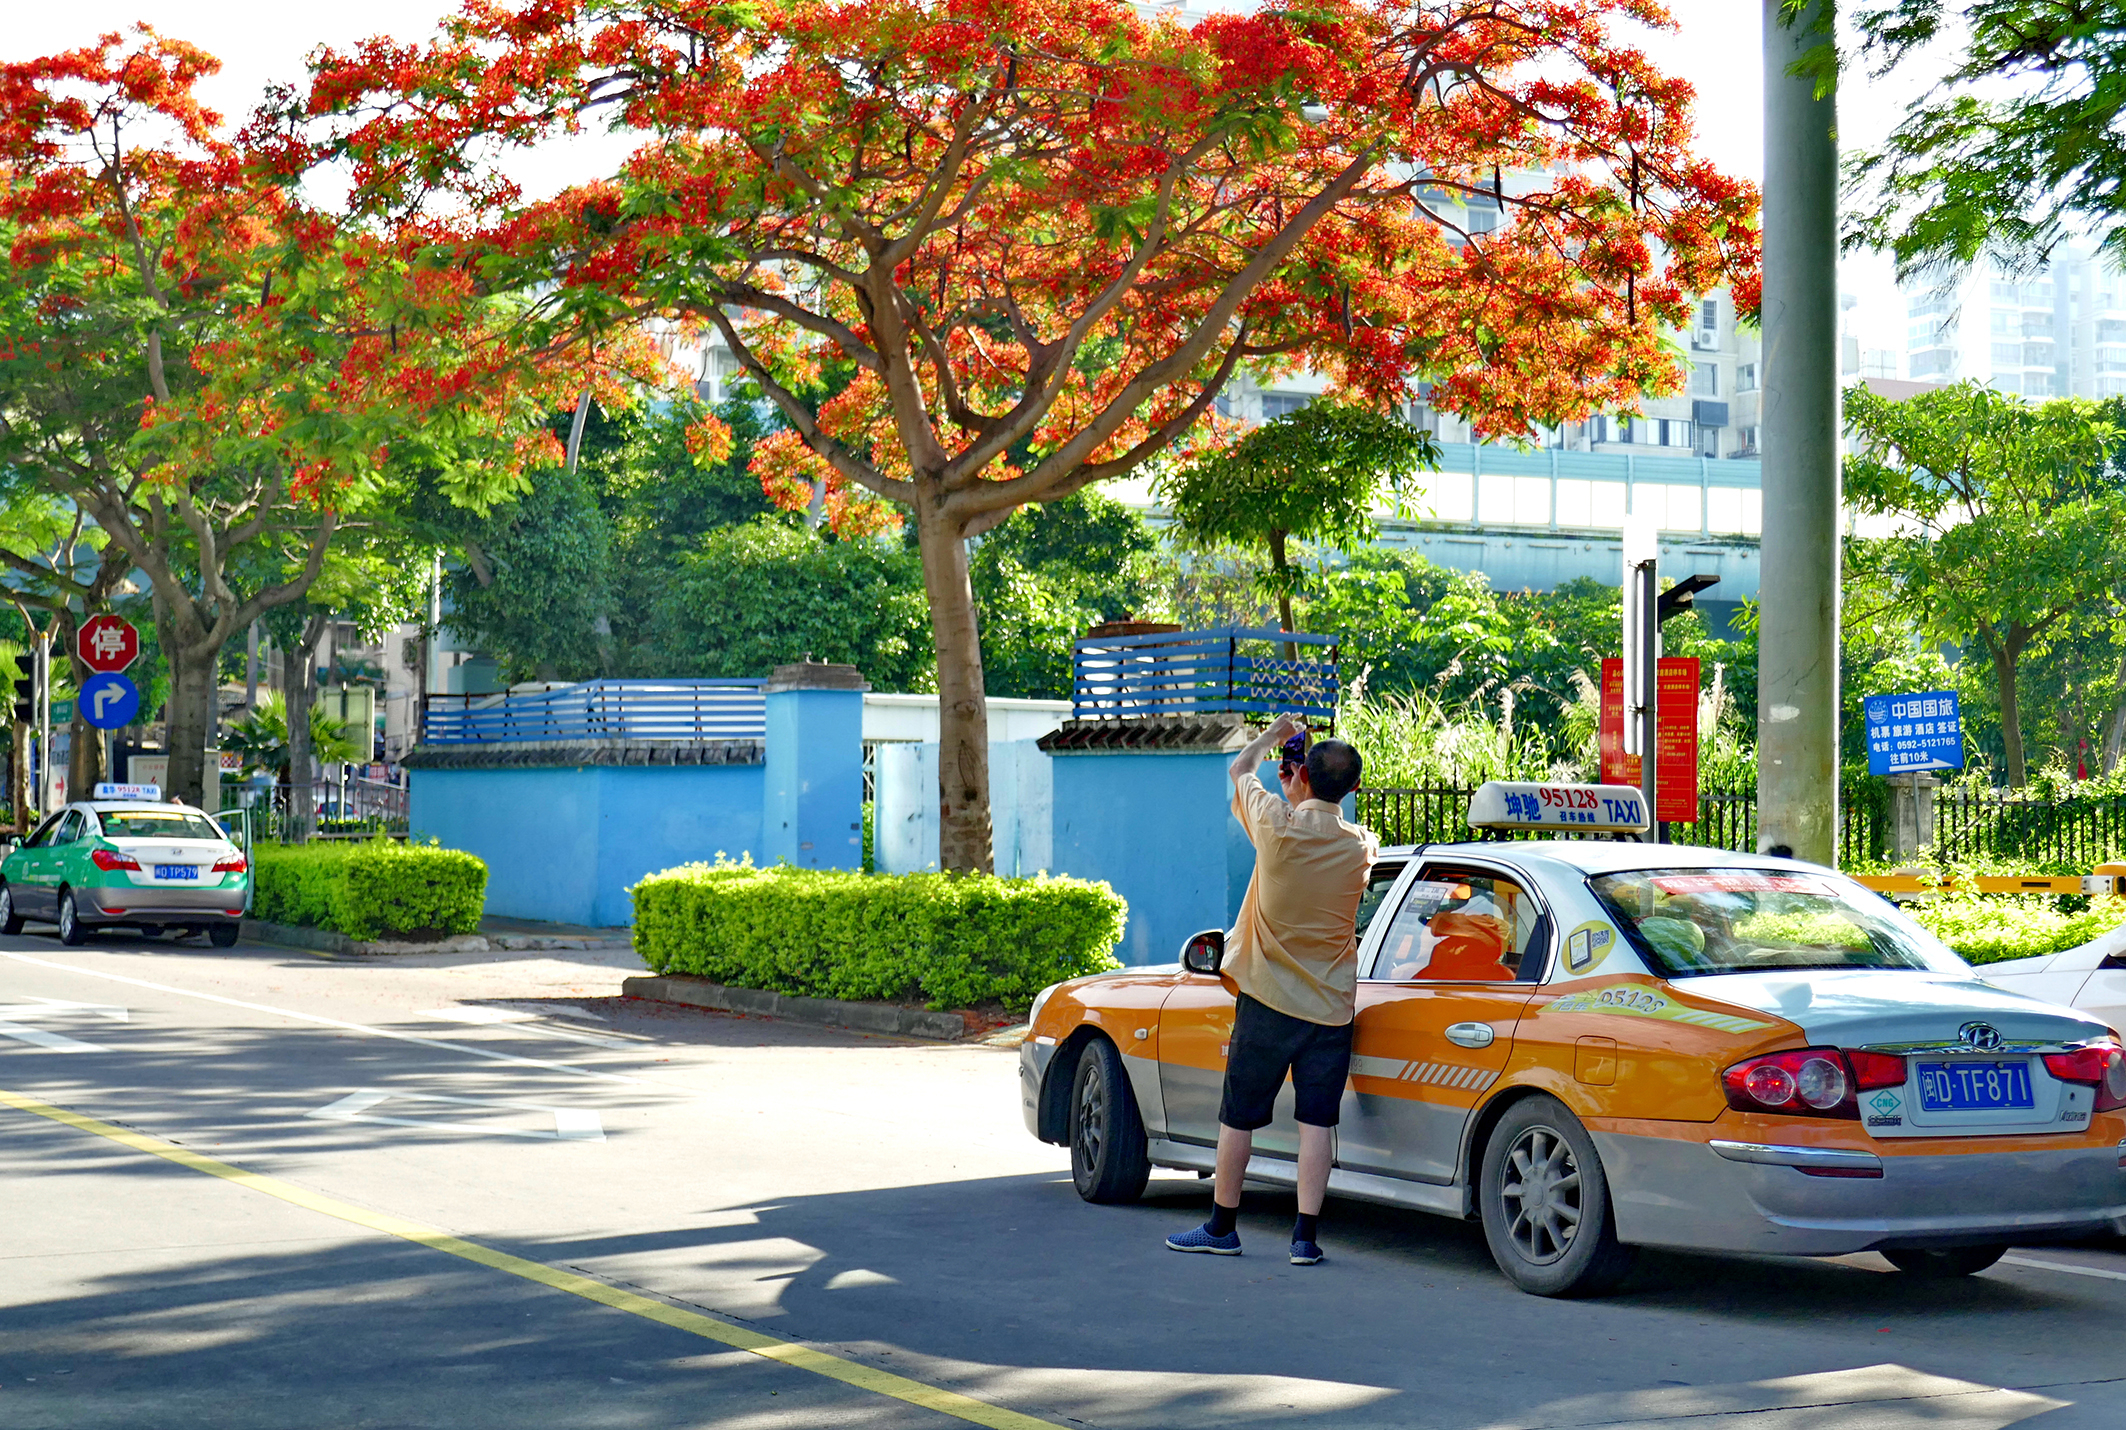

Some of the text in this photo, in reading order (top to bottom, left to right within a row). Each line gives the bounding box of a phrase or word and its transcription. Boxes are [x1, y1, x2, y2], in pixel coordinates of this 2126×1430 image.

[90, 625, 126, 660] 停
[1891, 698, 1954, 720] 中国国旅
[1870, 720, 1958, 739] 机票 旅游 酒店 签证
[1896, 737, 1956, 751] 0592-5121765
[1889, 751, 1929, 765] 往前10米
[142, 787, 157, 795] TAXI
[1504, 791, 1542, 822] 坤驰
[1539, 787, 1599, 810] 95128
[1603, 798, 1642, 824] TAXI
[1559, 810, 1596, 823] 召车热线
[1876, 1098, 1894, 1108] CNG
